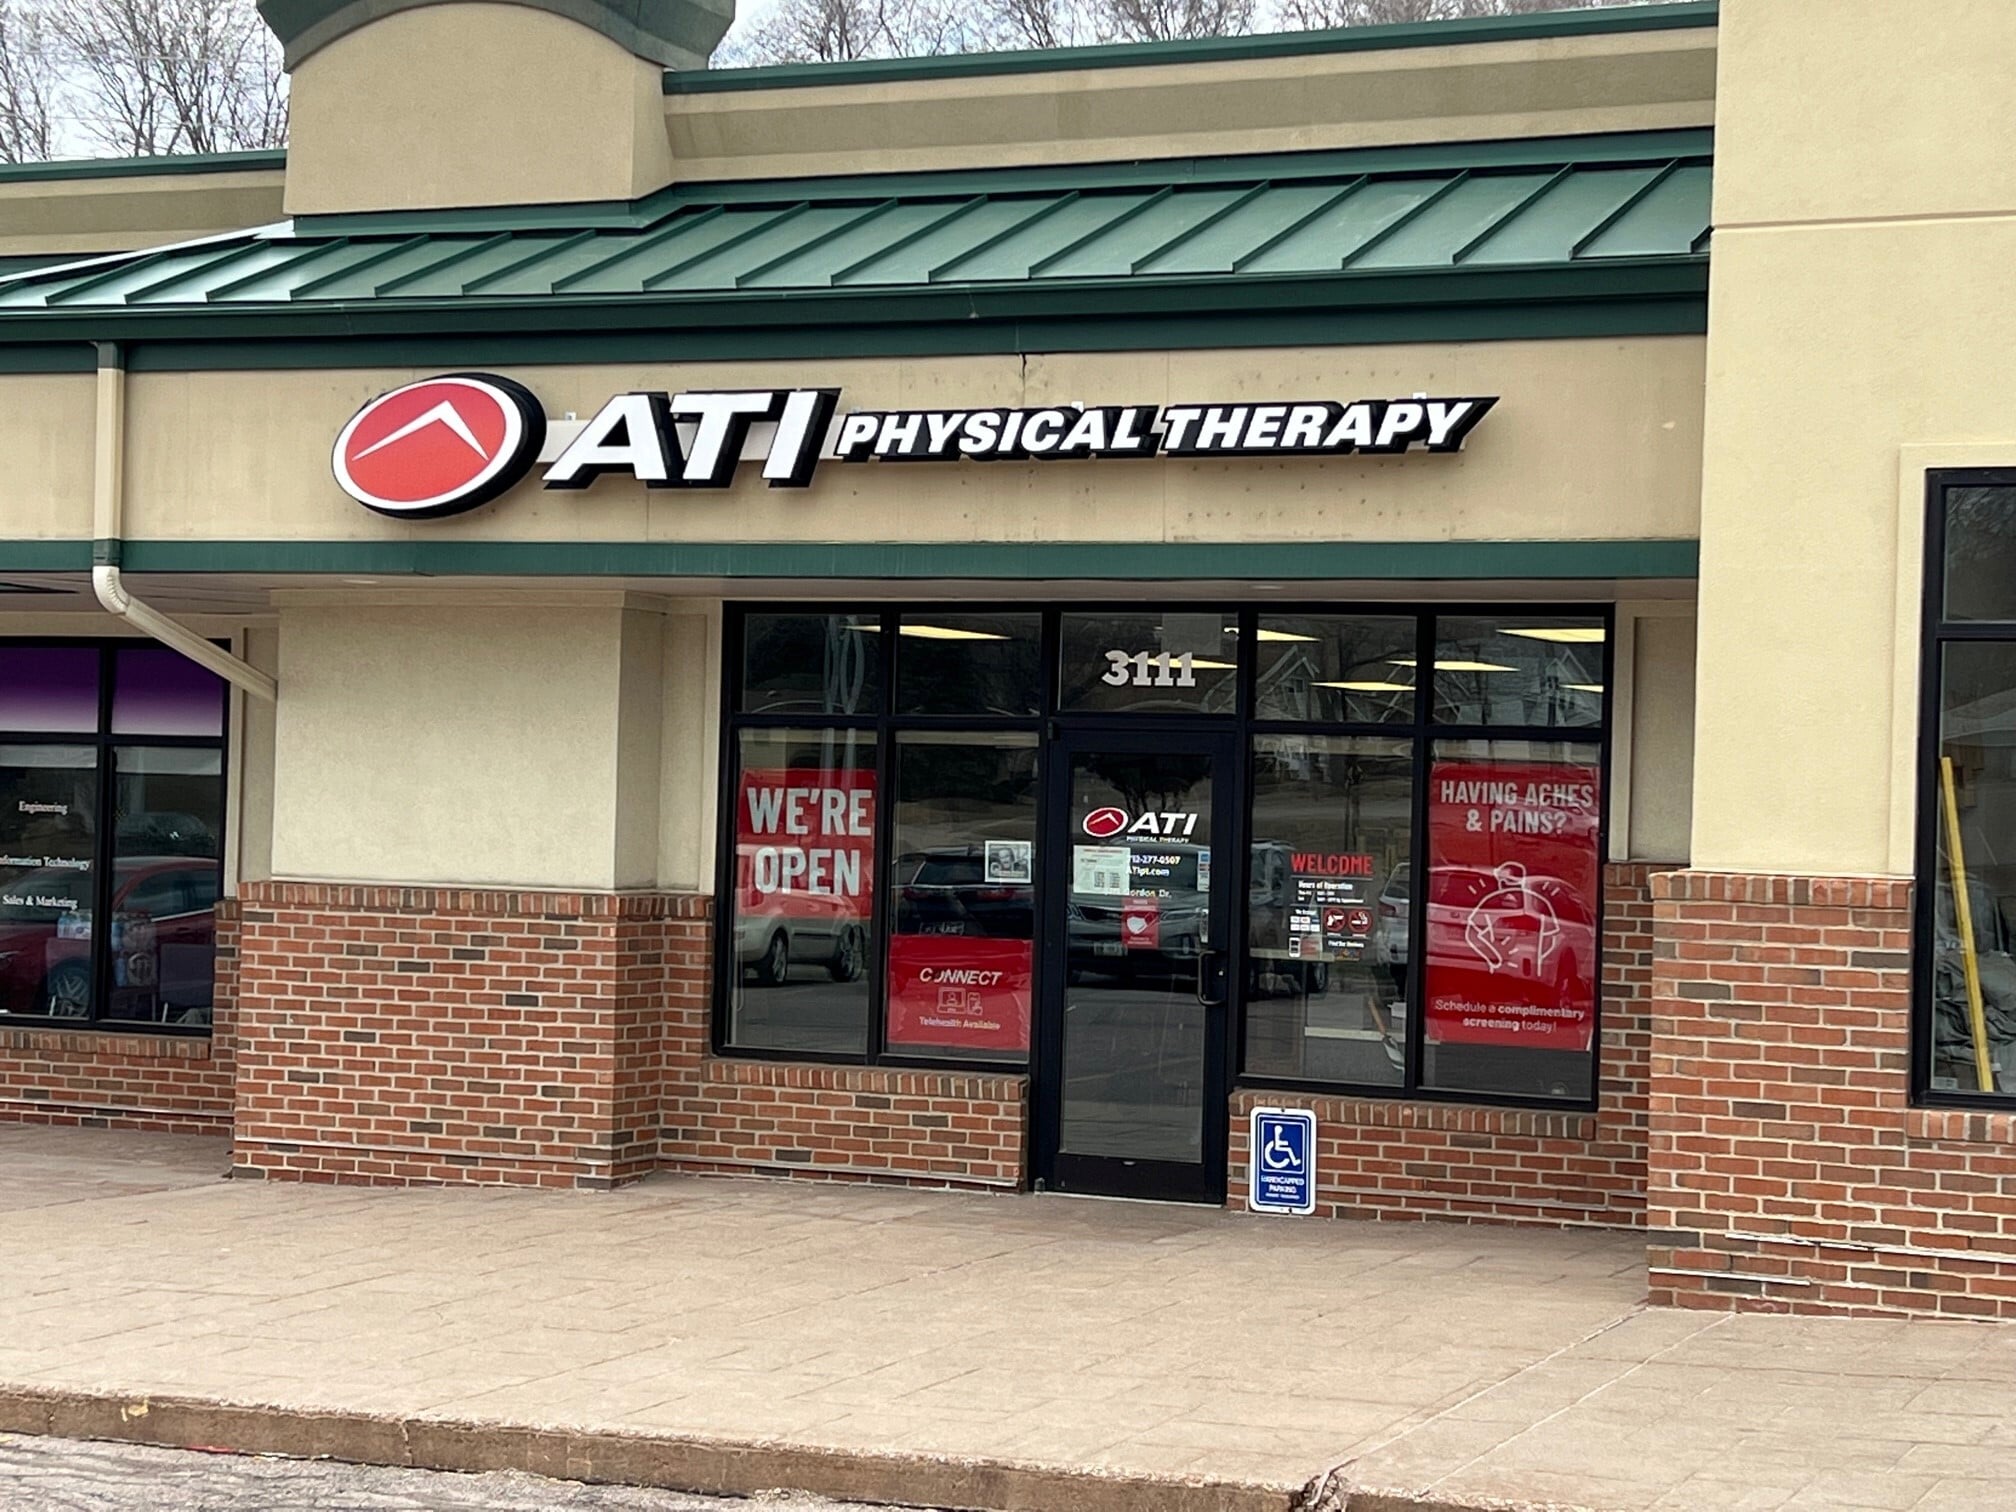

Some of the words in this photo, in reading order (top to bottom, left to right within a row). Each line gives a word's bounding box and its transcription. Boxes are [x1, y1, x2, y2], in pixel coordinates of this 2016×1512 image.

[542, 390, 820, 483] ATI
[836, 407, 1143, 455] PHYSICAL
[1163, 400, 1474, 450] THERAPY
[1101, 650, 1196, 687] 3111
[1441, 780, 1518, 805] HAVING
[1524, 783, 1593, 808] ACHES
[747, 787, 872, 837] WE'RE
[1127, 812, 1198, 835] ATI
[1466, 808, 1482, 832] &
[1490, 809, 1567, 834] PAINS?
[0, 854, 42, 866] nformation
[755, 847, 860, 896] OPEN
[1291, 853, 1374, 875] WELCOME
[25, 895, 34, 906] &
[1435, 999, 1486, 1013] Schedule
[1488, 1004, 1496, 1013] a
[1497, 1003, 1584, 1020] complimentary
[1462, 1016, 1520, 1031] screening
[1521, 1019, 1557, 1034] today!
